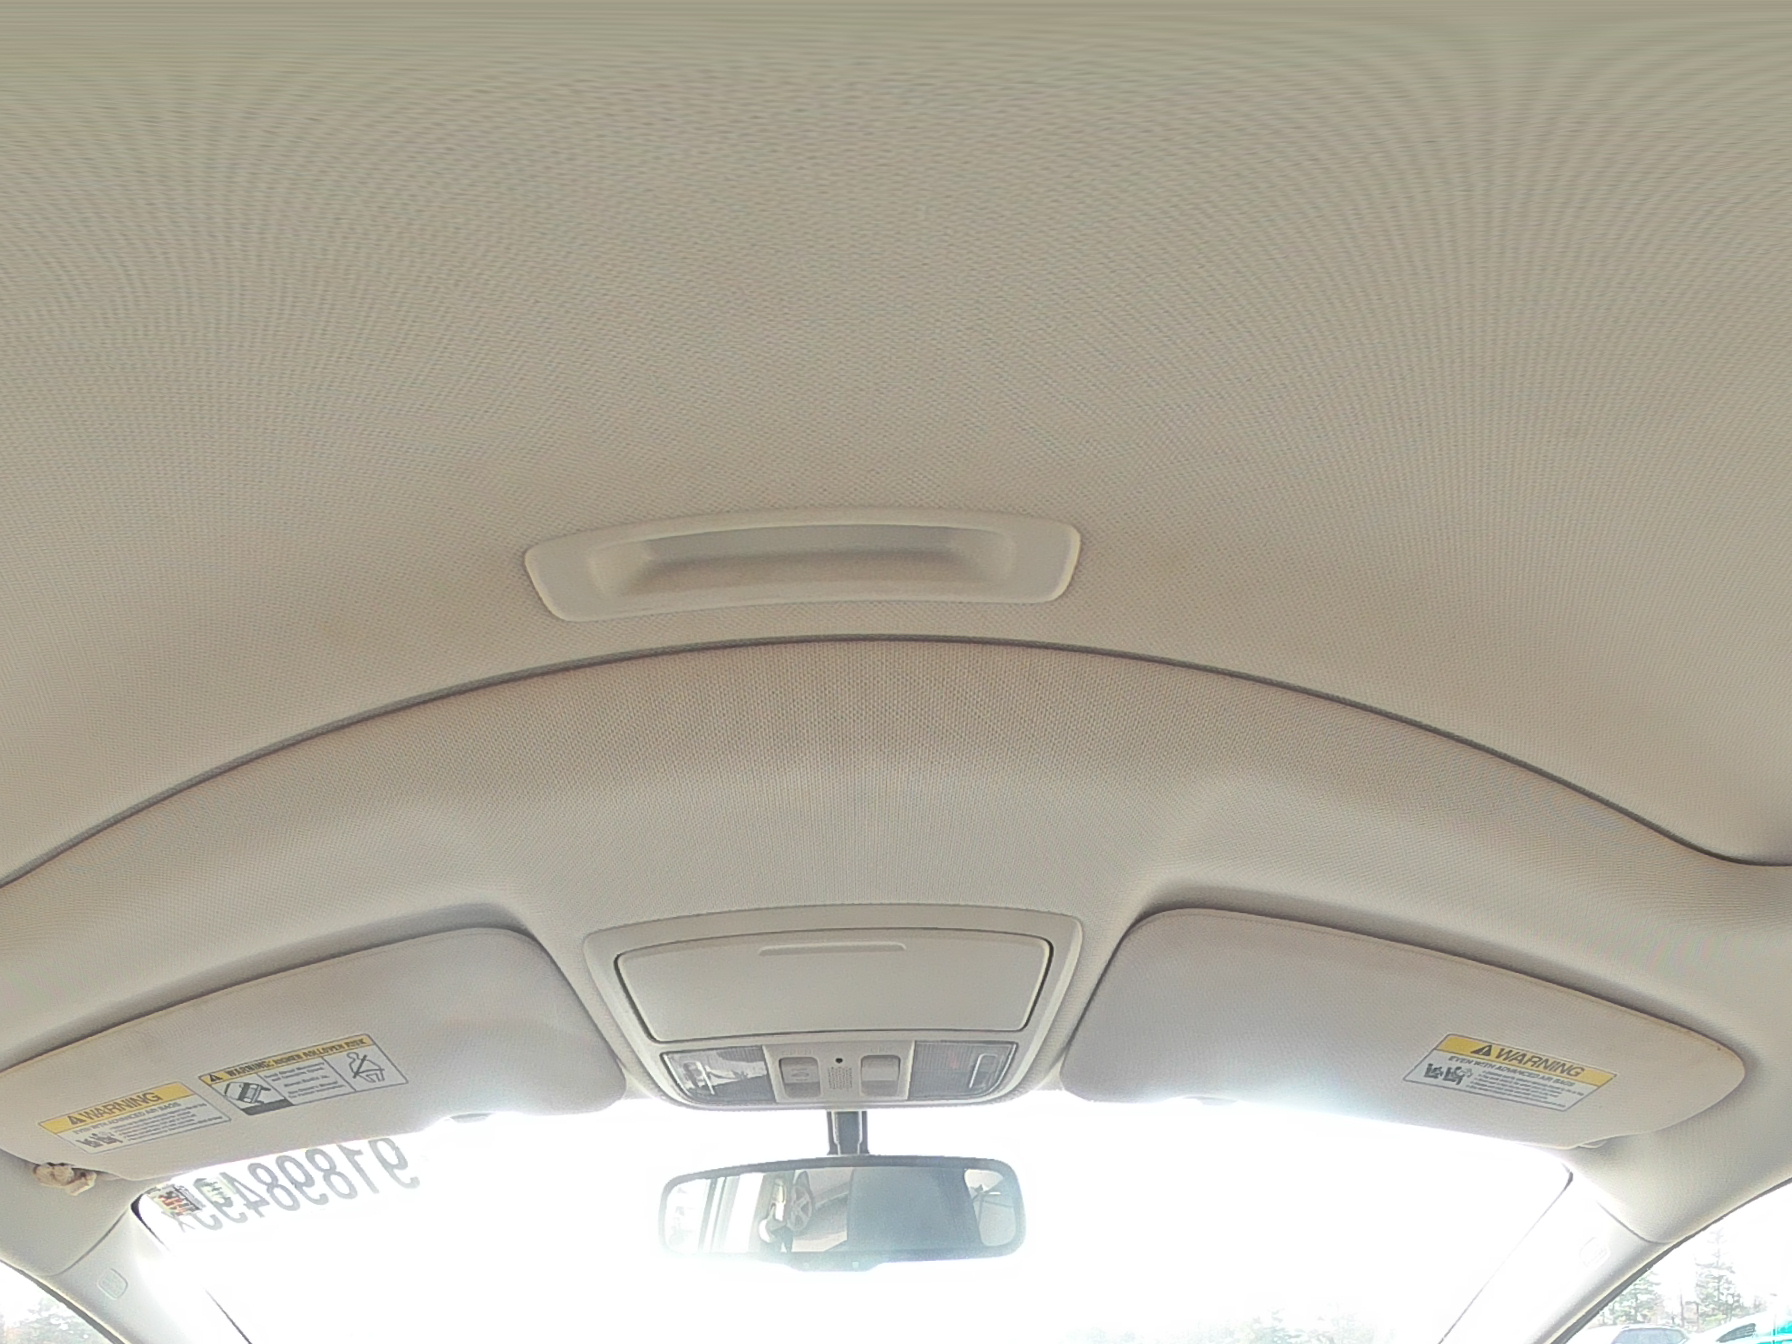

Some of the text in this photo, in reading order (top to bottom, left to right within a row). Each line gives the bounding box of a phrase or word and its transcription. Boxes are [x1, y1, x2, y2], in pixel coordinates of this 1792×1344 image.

[1496, 1047, 1585, 1077] WARNING
[1496, 1065, 1540, 1079] ADVANCED
[80, 1092, 162, 1121] WARNING
